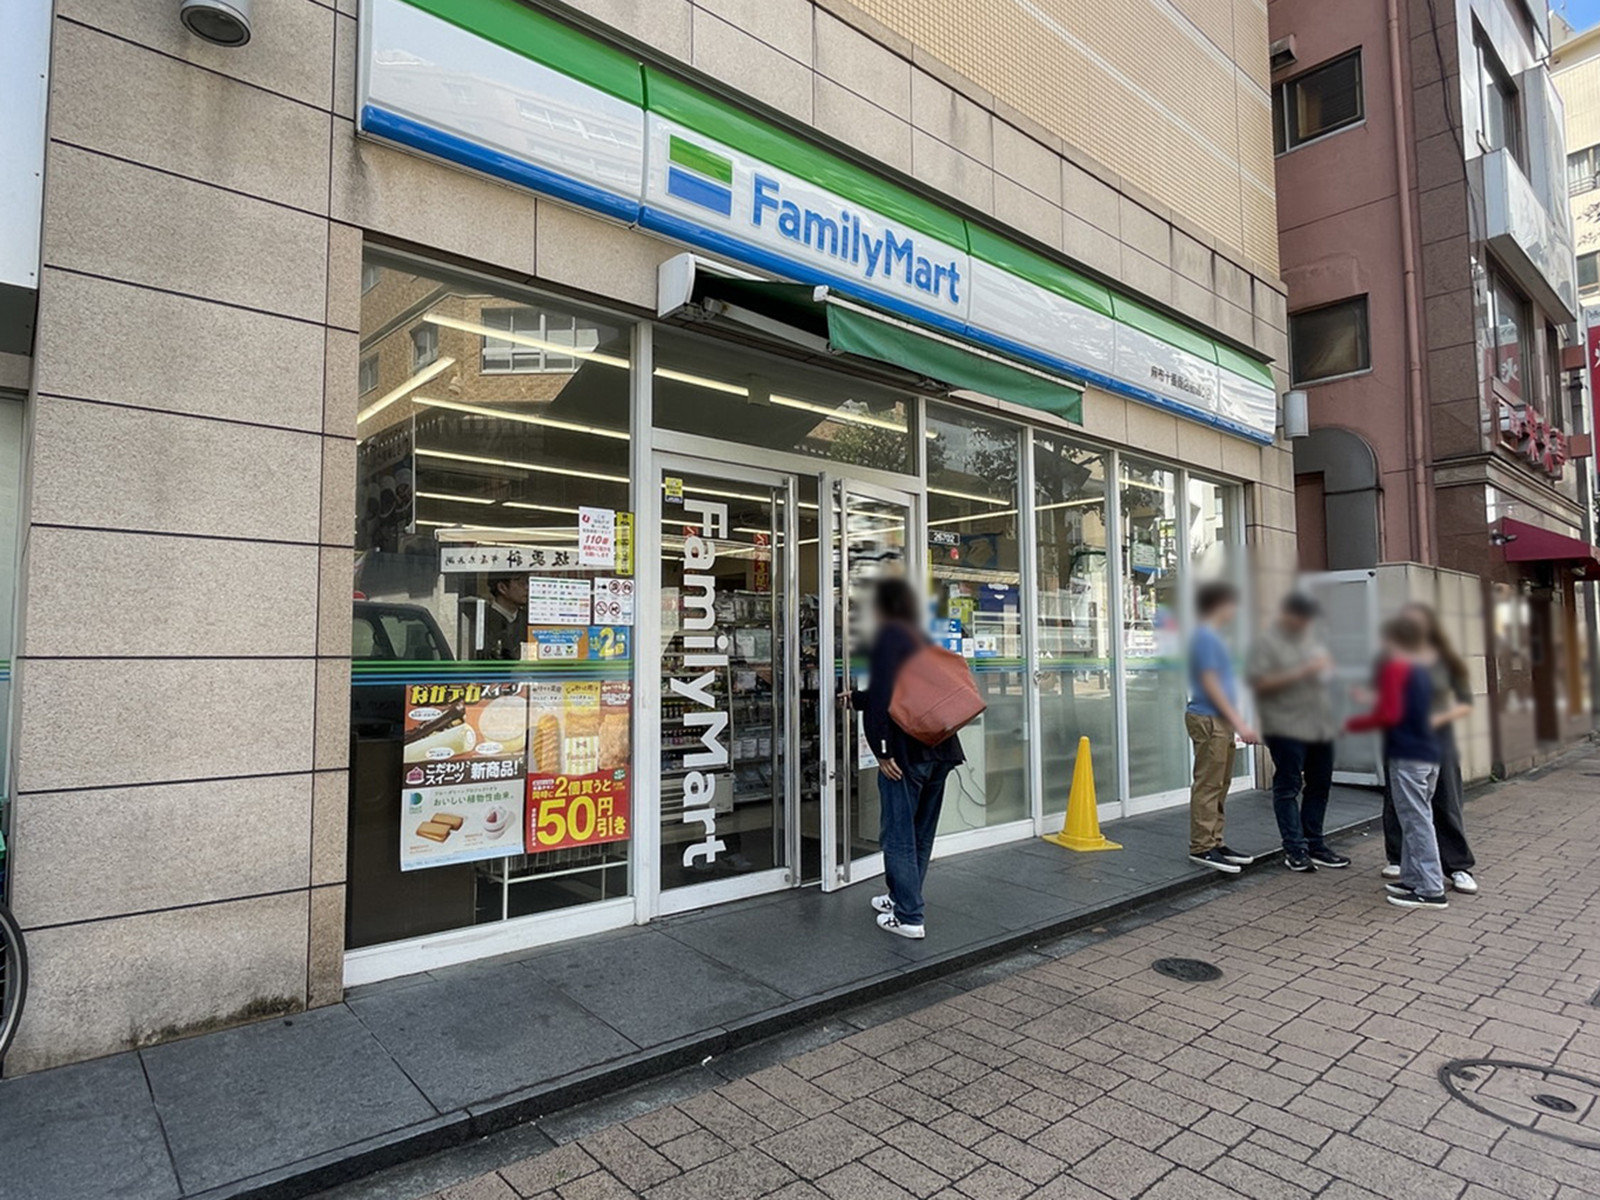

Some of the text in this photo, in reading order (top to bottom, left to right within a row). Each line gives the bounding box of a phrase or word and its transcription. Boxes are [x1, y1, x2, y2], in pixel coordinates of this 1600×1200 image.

[752, 172, 961, 303] FamilyMart
[670, 498, 729, 868] FamilyMart
[425, 773, 465, 785] スイーツ
[426, 760, 518, 780] こだわり 新商品!
[555, 776, 611, 798] 2個買うと
[433, 791, 515, 806] おいしい植物性由来。
